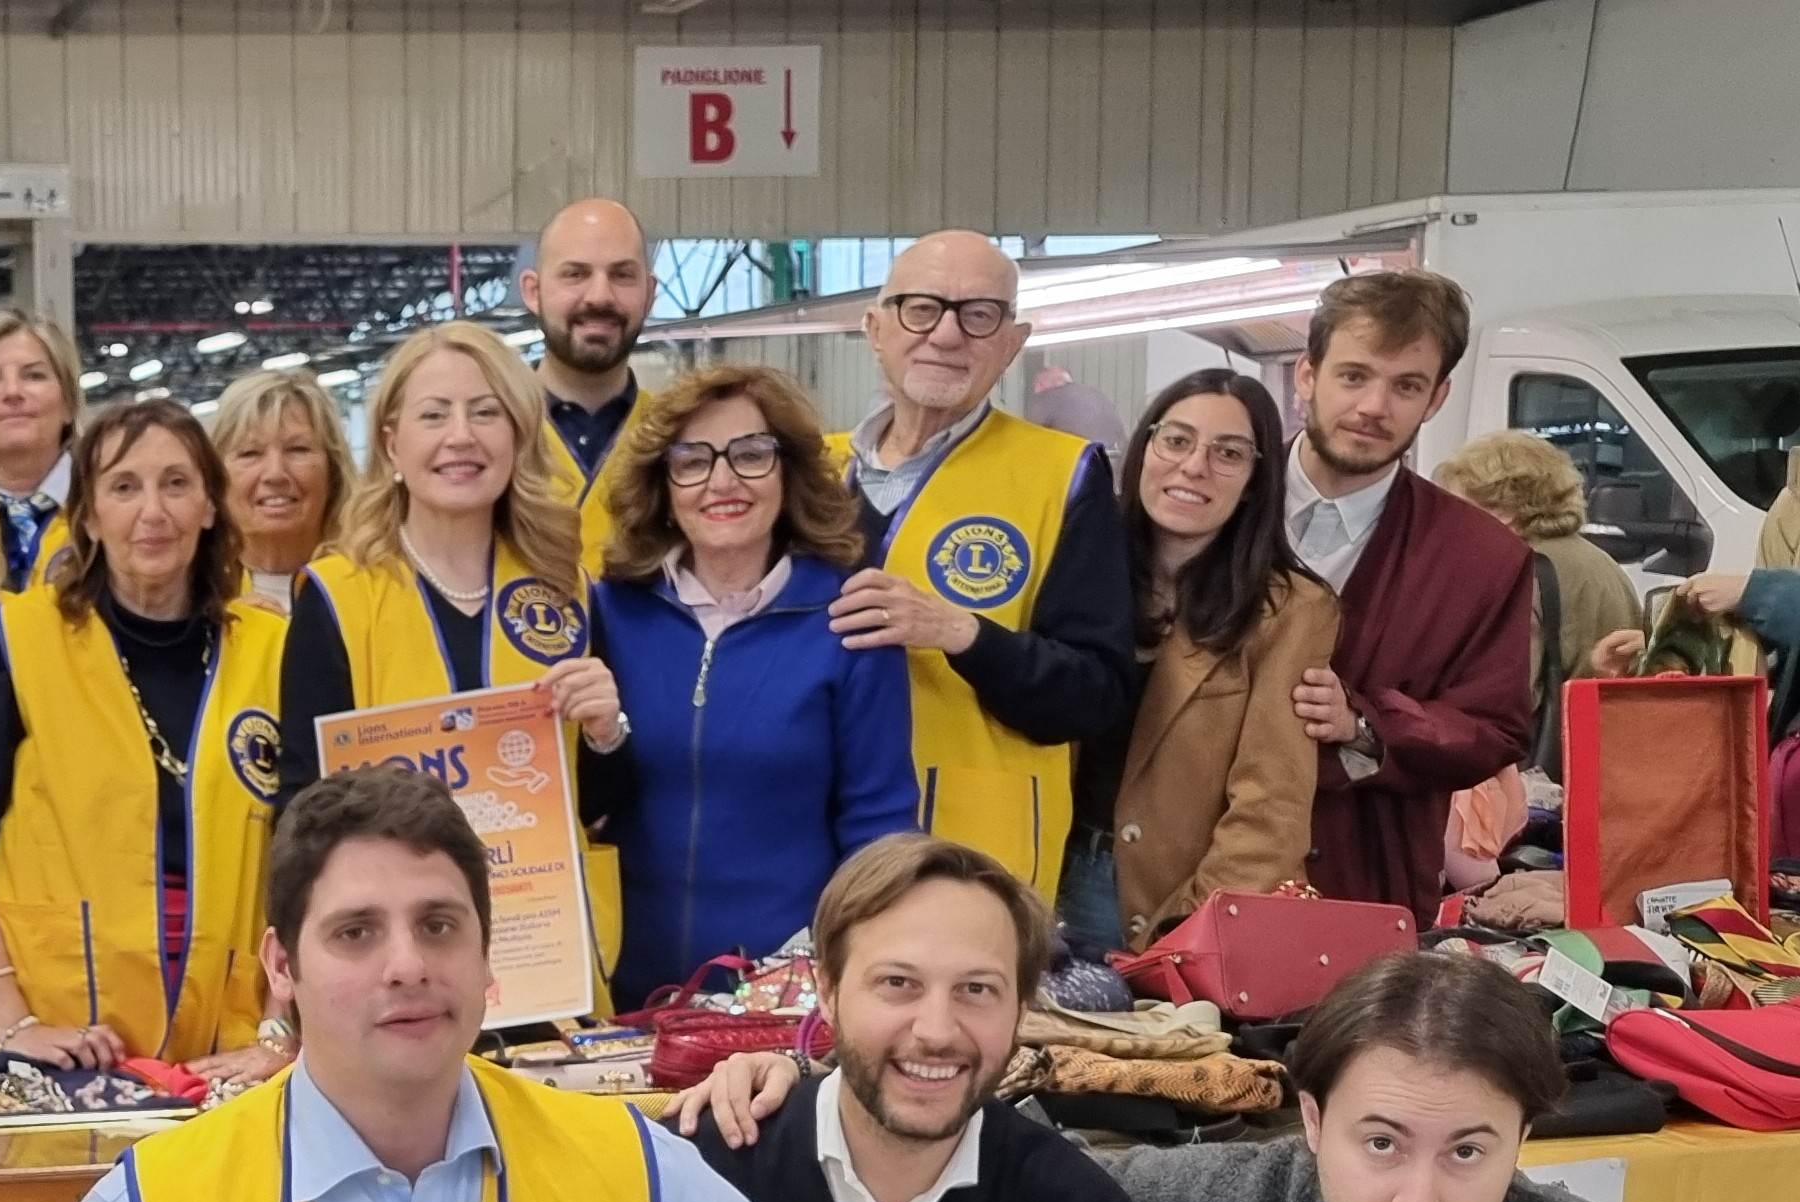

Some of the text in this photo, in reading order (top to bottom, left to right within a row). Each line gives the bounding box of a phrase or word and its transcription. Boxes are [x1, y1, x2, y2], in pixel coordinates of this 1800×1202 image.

[690, 92, 735, 163] B
[956, 527, 1004, 541] LIONS
[967, 544, 992, 574] L
[532, 603, 556, 632] L
[357, 722, 387, 737] Lions
[358, 723, 433, 745] International
